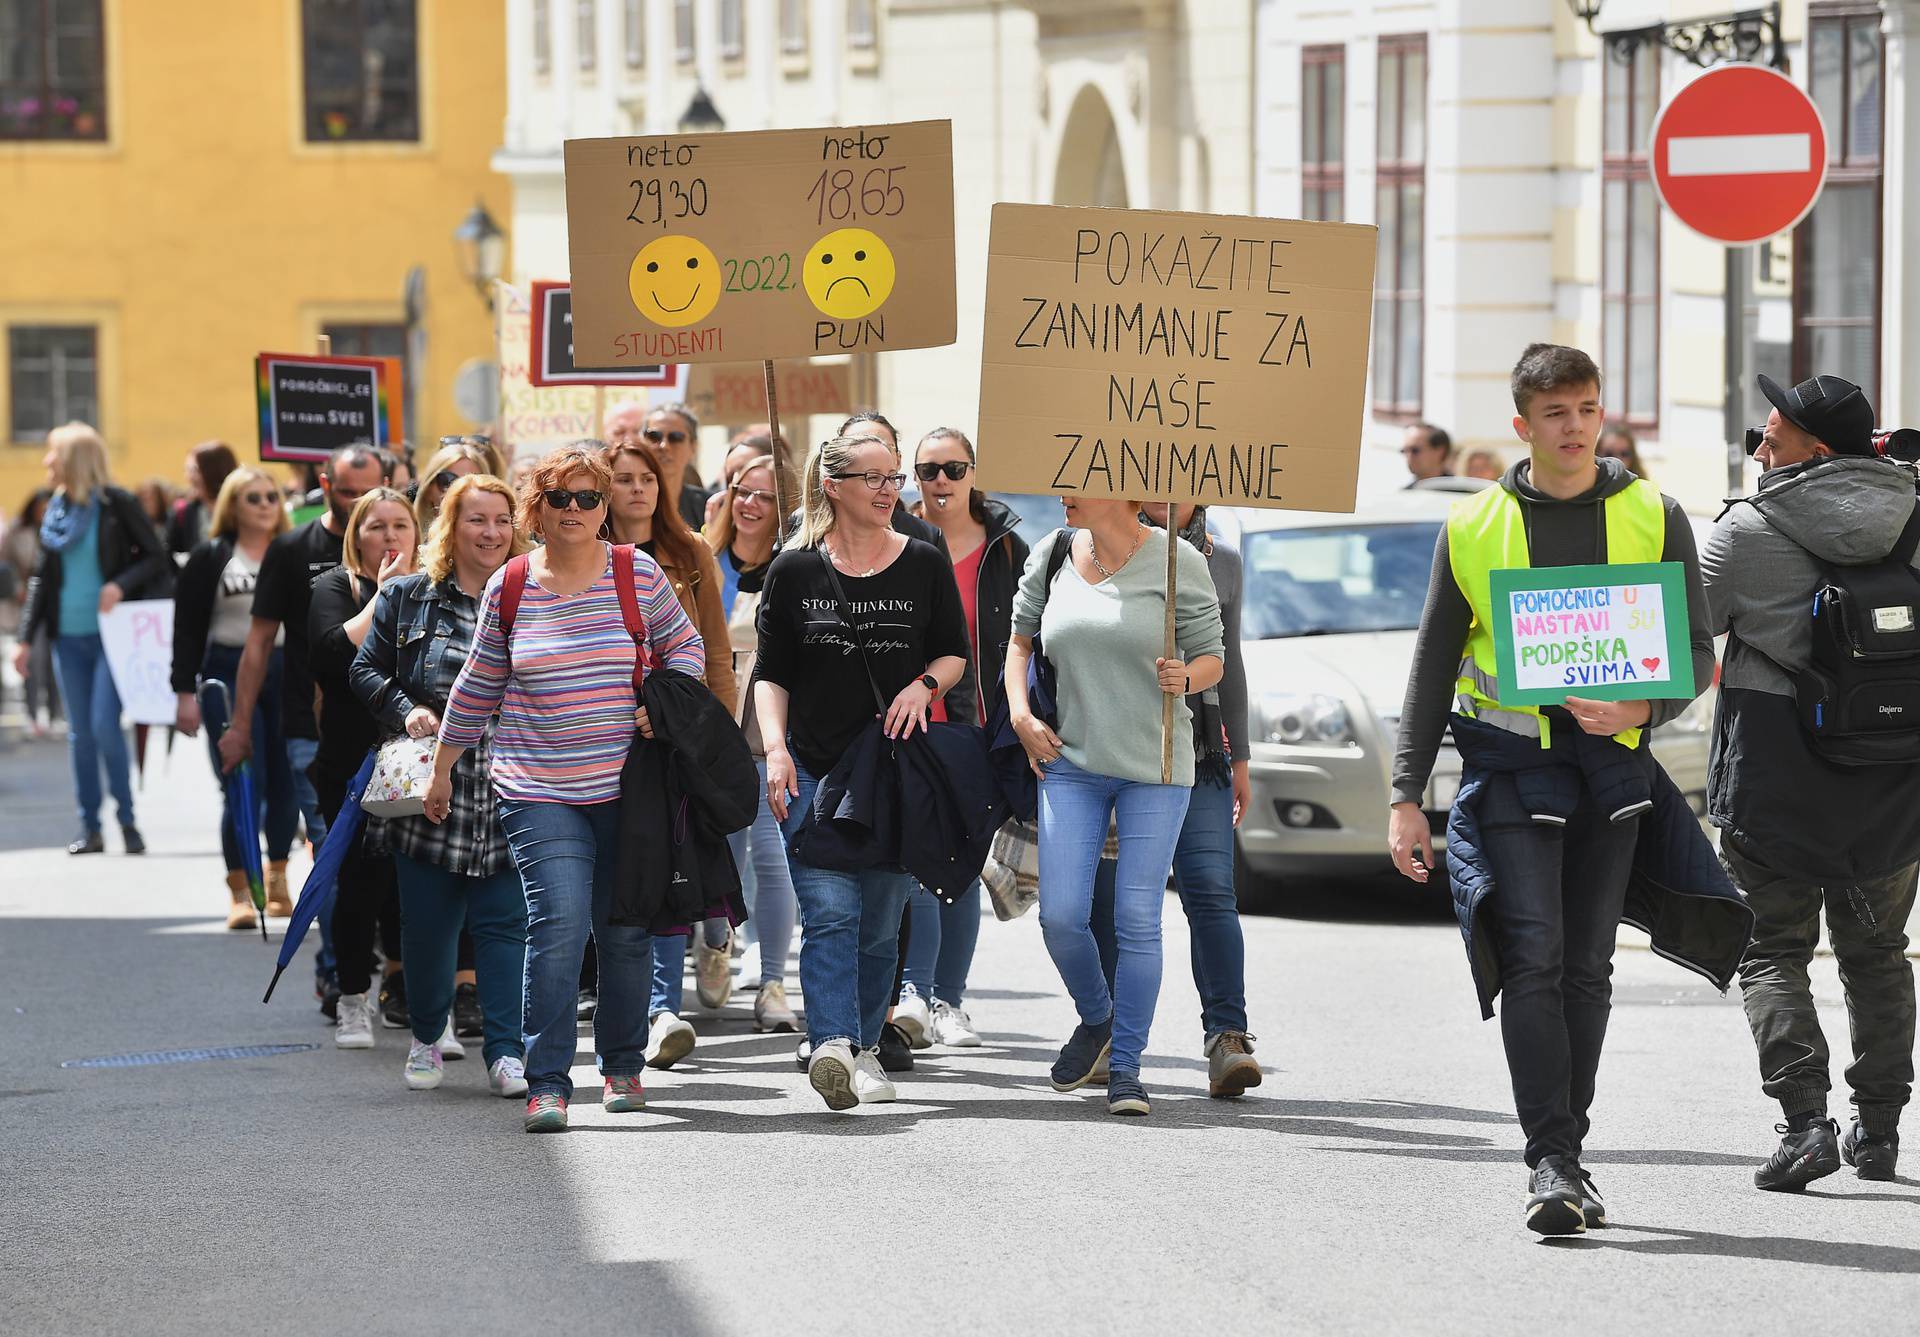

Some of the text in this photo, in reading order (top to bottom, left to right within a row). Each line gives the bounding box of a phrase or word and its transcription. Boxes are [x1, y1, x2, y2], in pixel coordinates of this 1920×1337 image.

[627, 131, 889, 167] neto neto
[626, 166, 907, 229] 29,30 18,65
[1075, 228, 1292, 295] POKAŽITE
[614, 327, 724, 358] STUDENTI
[815, 315, 885, 350] PUN
[1015, 297, 1312, 368] ZANIMANJE ZA
[298, 412, 325, 424] nam
[327, 410, 365, 427] SVE!
[1108, 373, 1217, 430] NAŠE
[1051, 433, 1289, 500] ZANIMANJE
[802, 598, 913, 614] STOP HINKING
[1513, 588, 1638, 614] POMOĆNICI U
[1517, 608, 1656, 637] NASTAVI SU
[820, 632, 858, 656] thing
[1521, 635, 1629, 667] PODRŠKA
[1563, 661, 1638, 685] SVIMA
